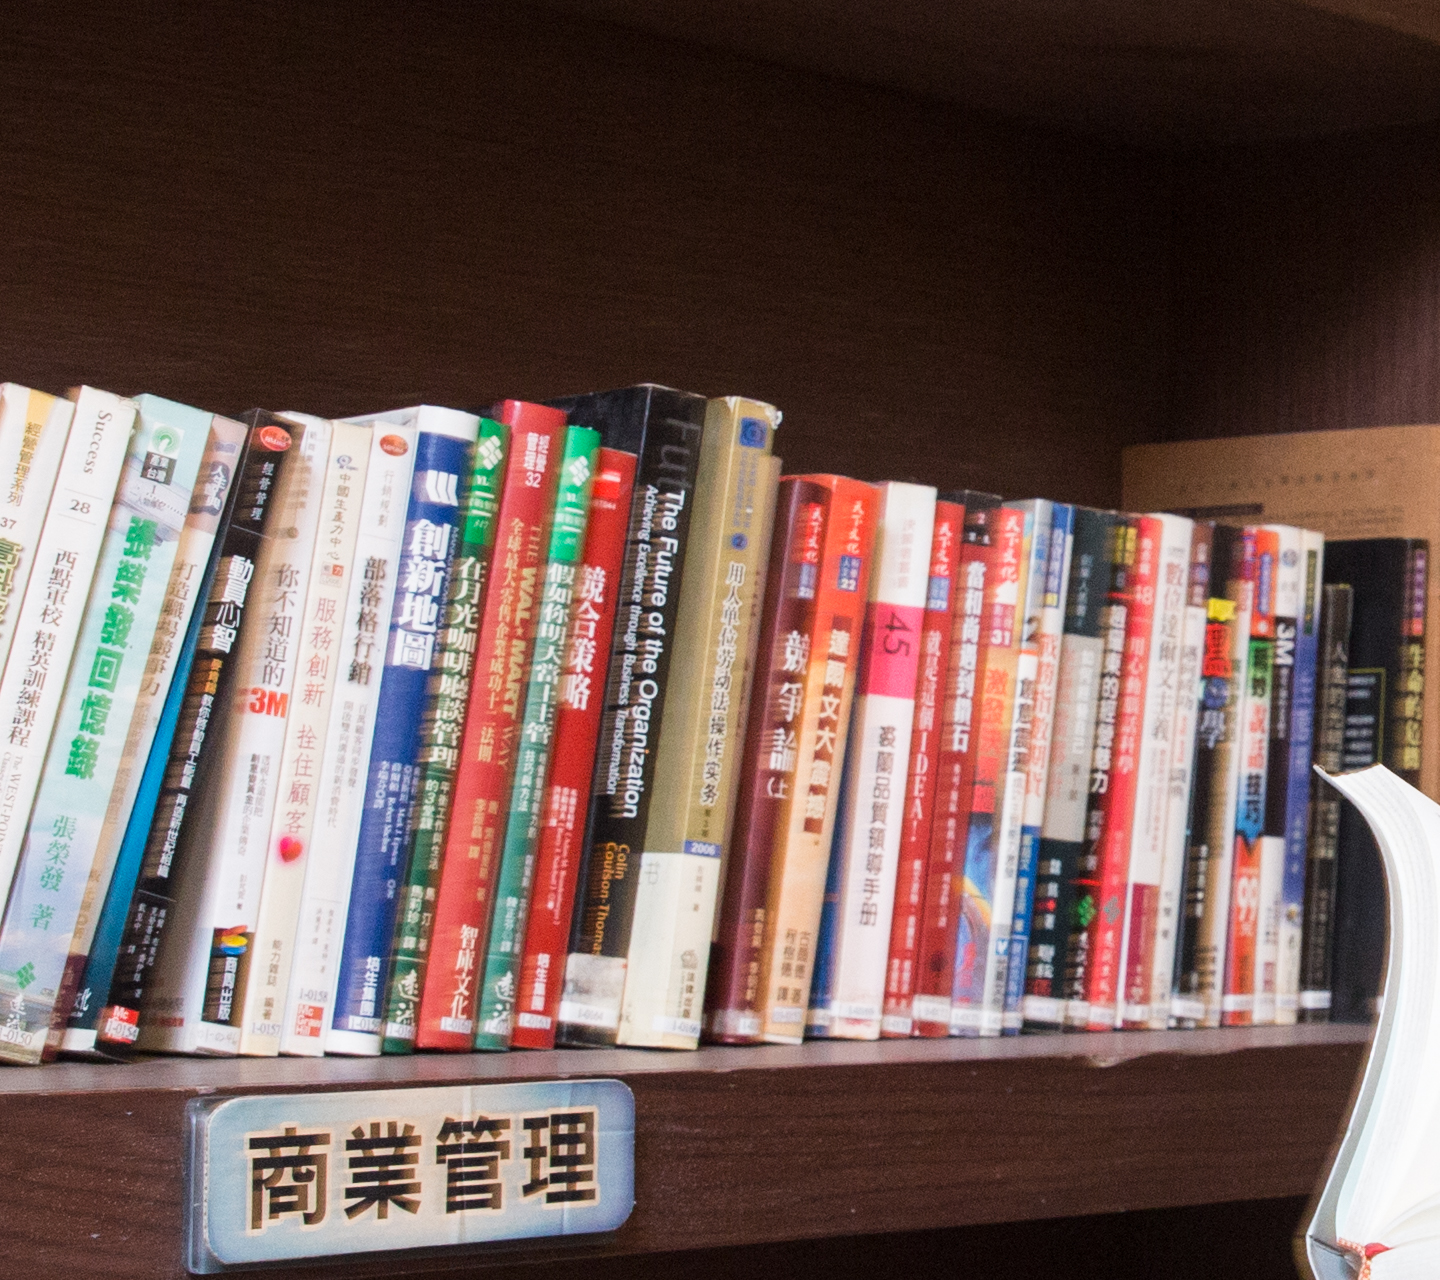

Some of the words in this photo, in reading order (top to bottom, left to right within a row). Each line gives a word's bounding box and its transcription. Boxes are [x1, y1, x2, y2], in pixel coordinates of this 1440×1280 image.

[83, 409, 113, 475] Success
[525, 472, 541, 488] 32
[0, 516, 17, 531] 37
[69, 499, 92, 516] 28
[250, 461, 275, 520] 經營管理
[326, 472, 350, 561] 中國生產力中心
[637, 485, 658, 541] Achieving
[661, 490, 684, 530] The
[630, 543, 651, 601] Excellence
[650, 536, 679, 606] Future
[996, 514, 1020, 581] 天下文化
[38, 548, 80, 628] 西點軍校
[211, 554, 254, 654] 動員心智
[261, 563, 300, 688] 你不知道的
[348, 556, 388, 686] 部落格行銷
[392, 518, 452, 671] 創新地圖
[623, 604, 642, 650] through
[645, 613, 666, 636] of
[64, 515, 163, 780] 張榮發回憶錄
[301, 598, 336, 708] 服務創新
[523, 561, 576, 745] 假如你明天當上主管
[562, 566, 606, 711] 競合策略
[639, 641, 663, 673] the
[951, 560, 987, 753] 當和尚遇到鑽石
[6, 629, 57, 749] 精英訓練課程
[249, 688, 289, 718] 3M
[617, 653, 637, 705] Business
[698, 560, 746, 806] 用人单位劳动法操作实务
[768, 630, 811, 772] 競爭論
[12, 755, 23, 769] The
[605, 709, 630, 794] Transformation
[622, 678, 658, 818] Organization
[805, 629, 851, 820] 達爾文大震撼
[285, 724, 317, 834] 拴住顧客
[38, 814, 78, 894] 張榮發
[614, 844, 630, 878] Colin
[689, 842, 718, 857] 2006
[29, 905, 56, 932] 著
[450, 924, 478, 1019] 智庫文化
[247, 1109, 598, 1232] 商業管理
